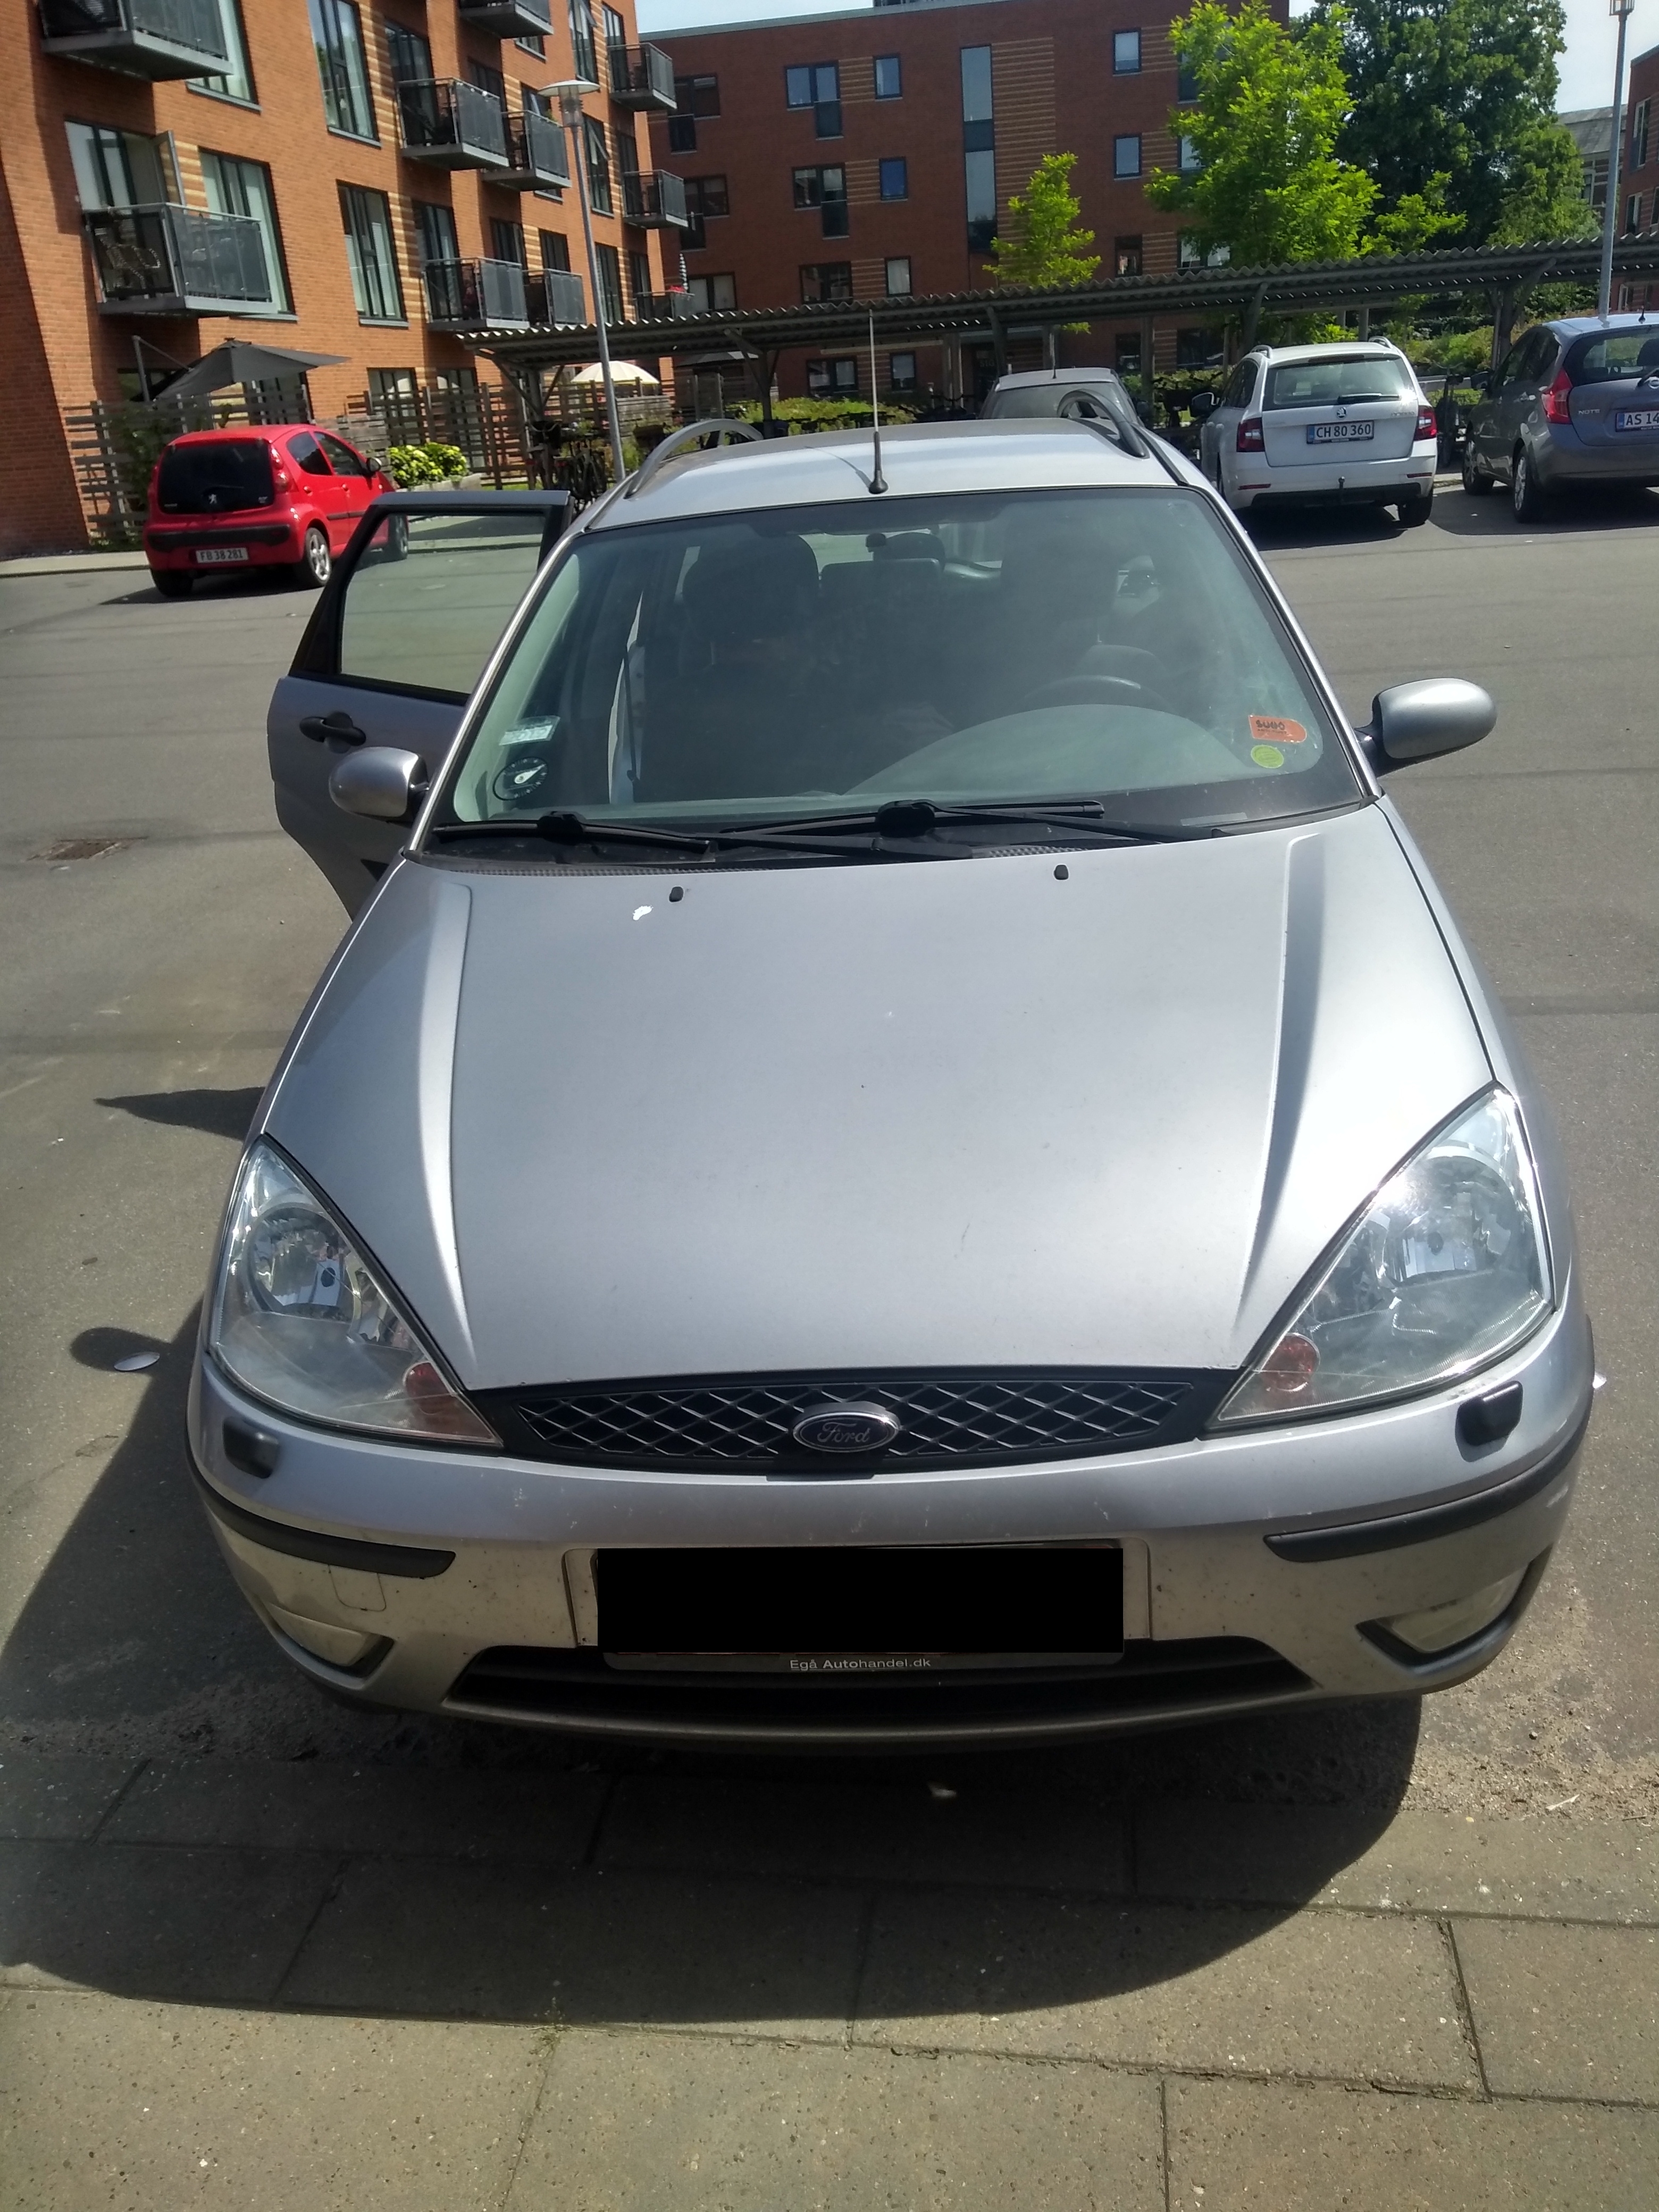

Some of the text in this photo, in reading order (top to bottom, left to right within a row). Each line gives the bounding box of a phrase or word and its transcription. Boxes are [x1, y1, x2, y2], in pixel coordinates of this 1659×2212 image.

[1626, 412, 1659, 425] AS 14
[1317, 424, 1371, 438] CH 80 360
[200, 549, 243, 560] FB 38 281
[817, 1421, 871, 1443] Ford
[790, 1658, 931, 1671] Egå Autohandel.dk
